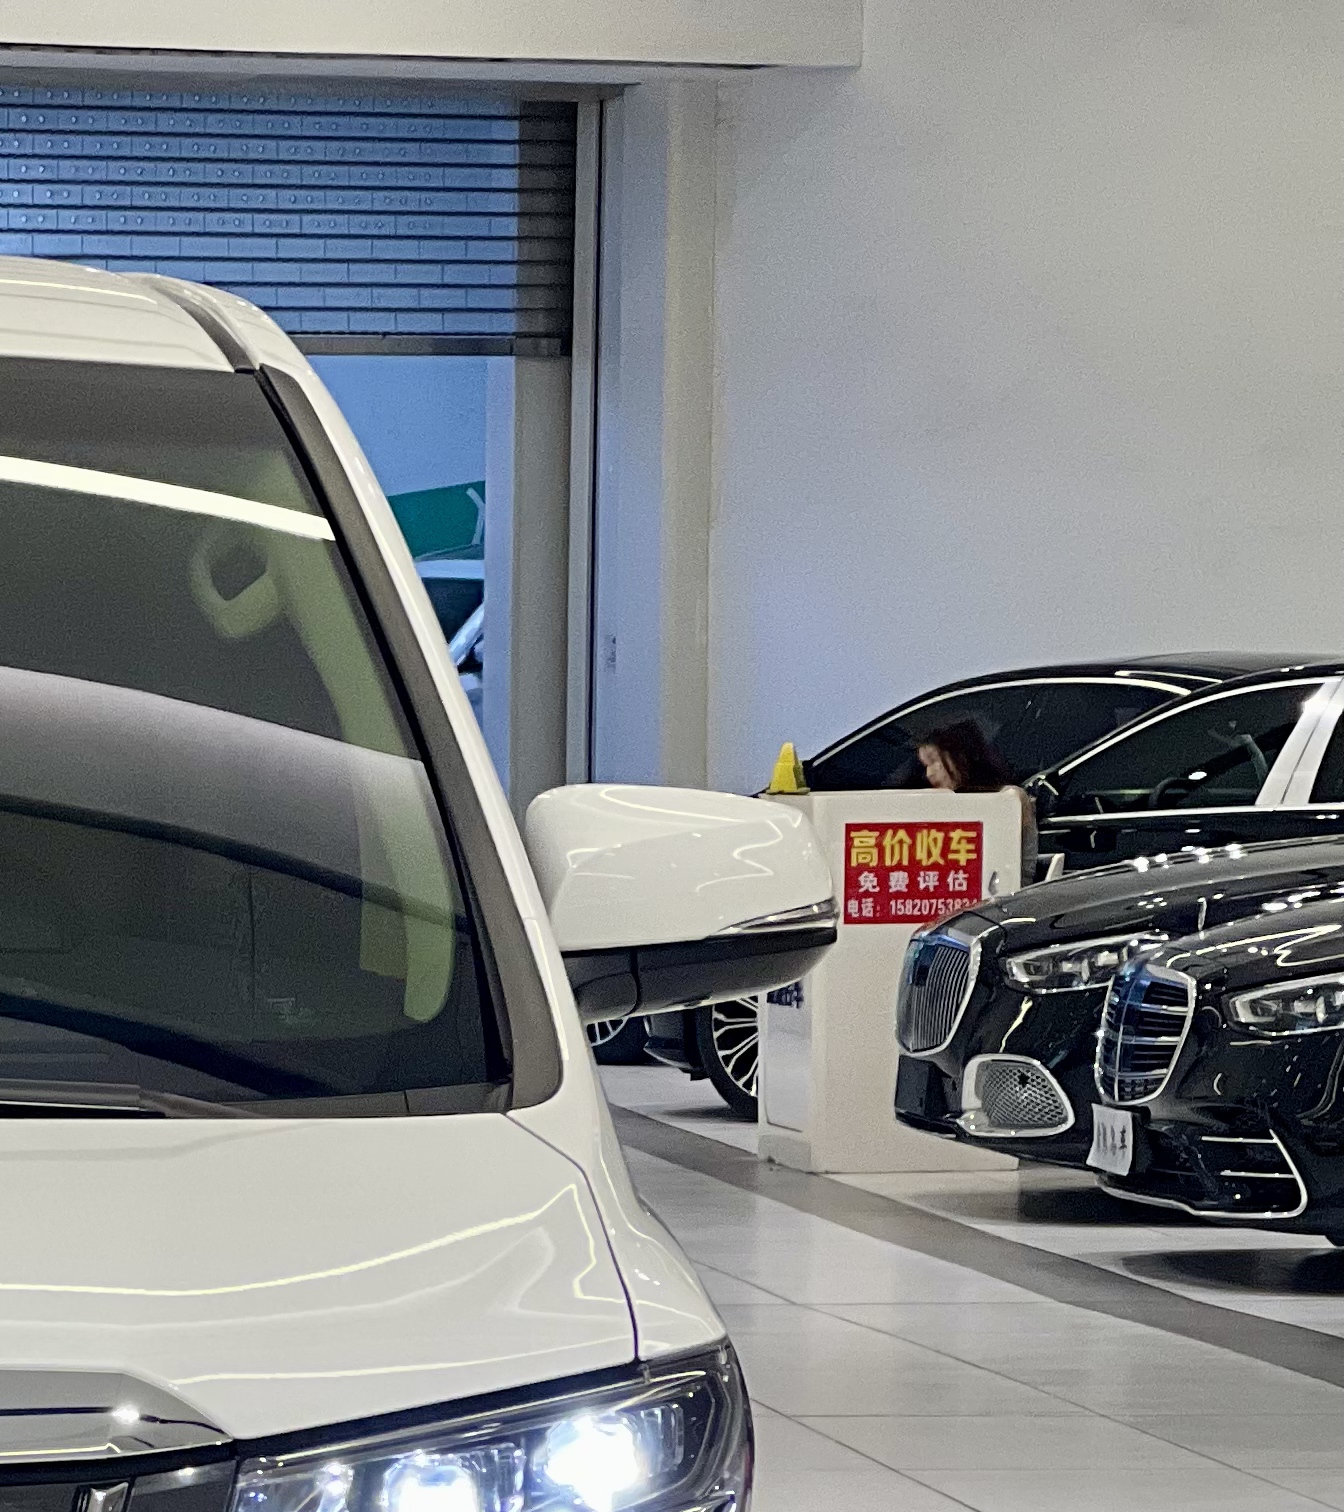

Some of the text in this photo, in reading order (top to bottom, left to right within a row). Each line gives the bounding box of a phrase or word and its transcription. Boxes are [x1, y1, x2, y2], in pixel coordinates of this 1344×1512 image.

[850, 829, 977, 867] 高价收车
[858, 870, 969, 892] 免费评估
